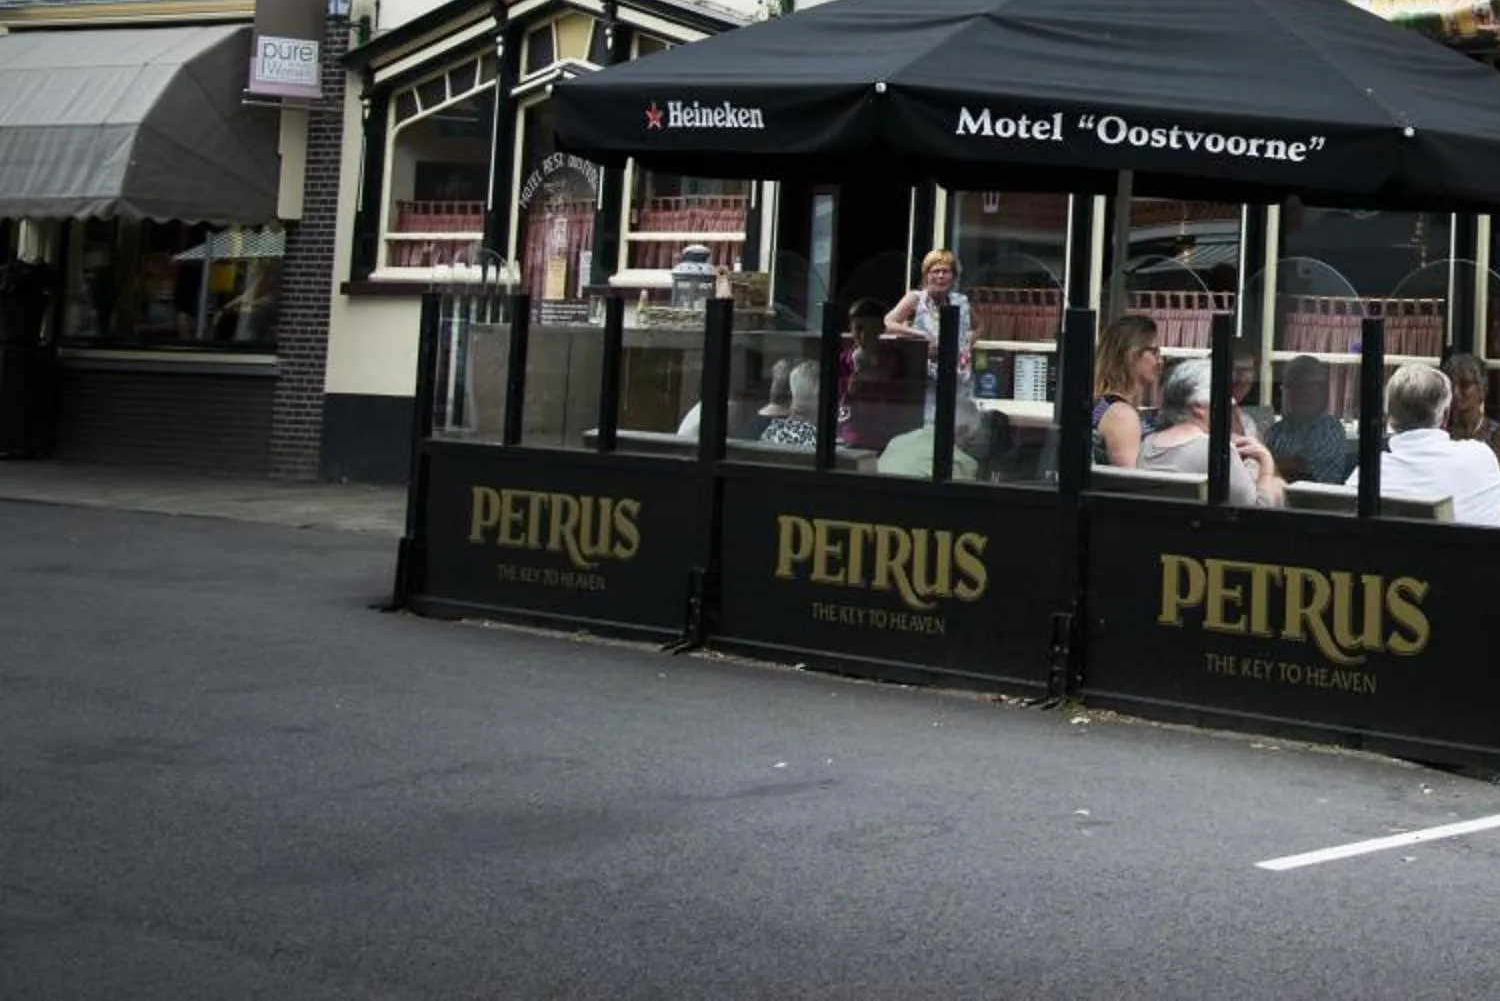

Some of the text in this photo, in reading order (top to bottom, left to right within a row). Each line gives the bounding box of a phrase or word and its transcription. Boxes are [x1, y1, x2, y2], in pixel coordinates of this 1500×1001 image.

[263, 42, 313, 74] pure
[667, 101, 765, 129] Heineken
[955, 106, 1063, 141] Motel
[468, 485, 641, 566] PETRUS
[775, 514, 988, 608] PETRUS
[812, 602, 946, 635] THE KEY TO HEAVEN
[1157, 553, 1430, 664] PETRUS
[1205, 653, 1377, 694] THE KEY TO HEAVEN
